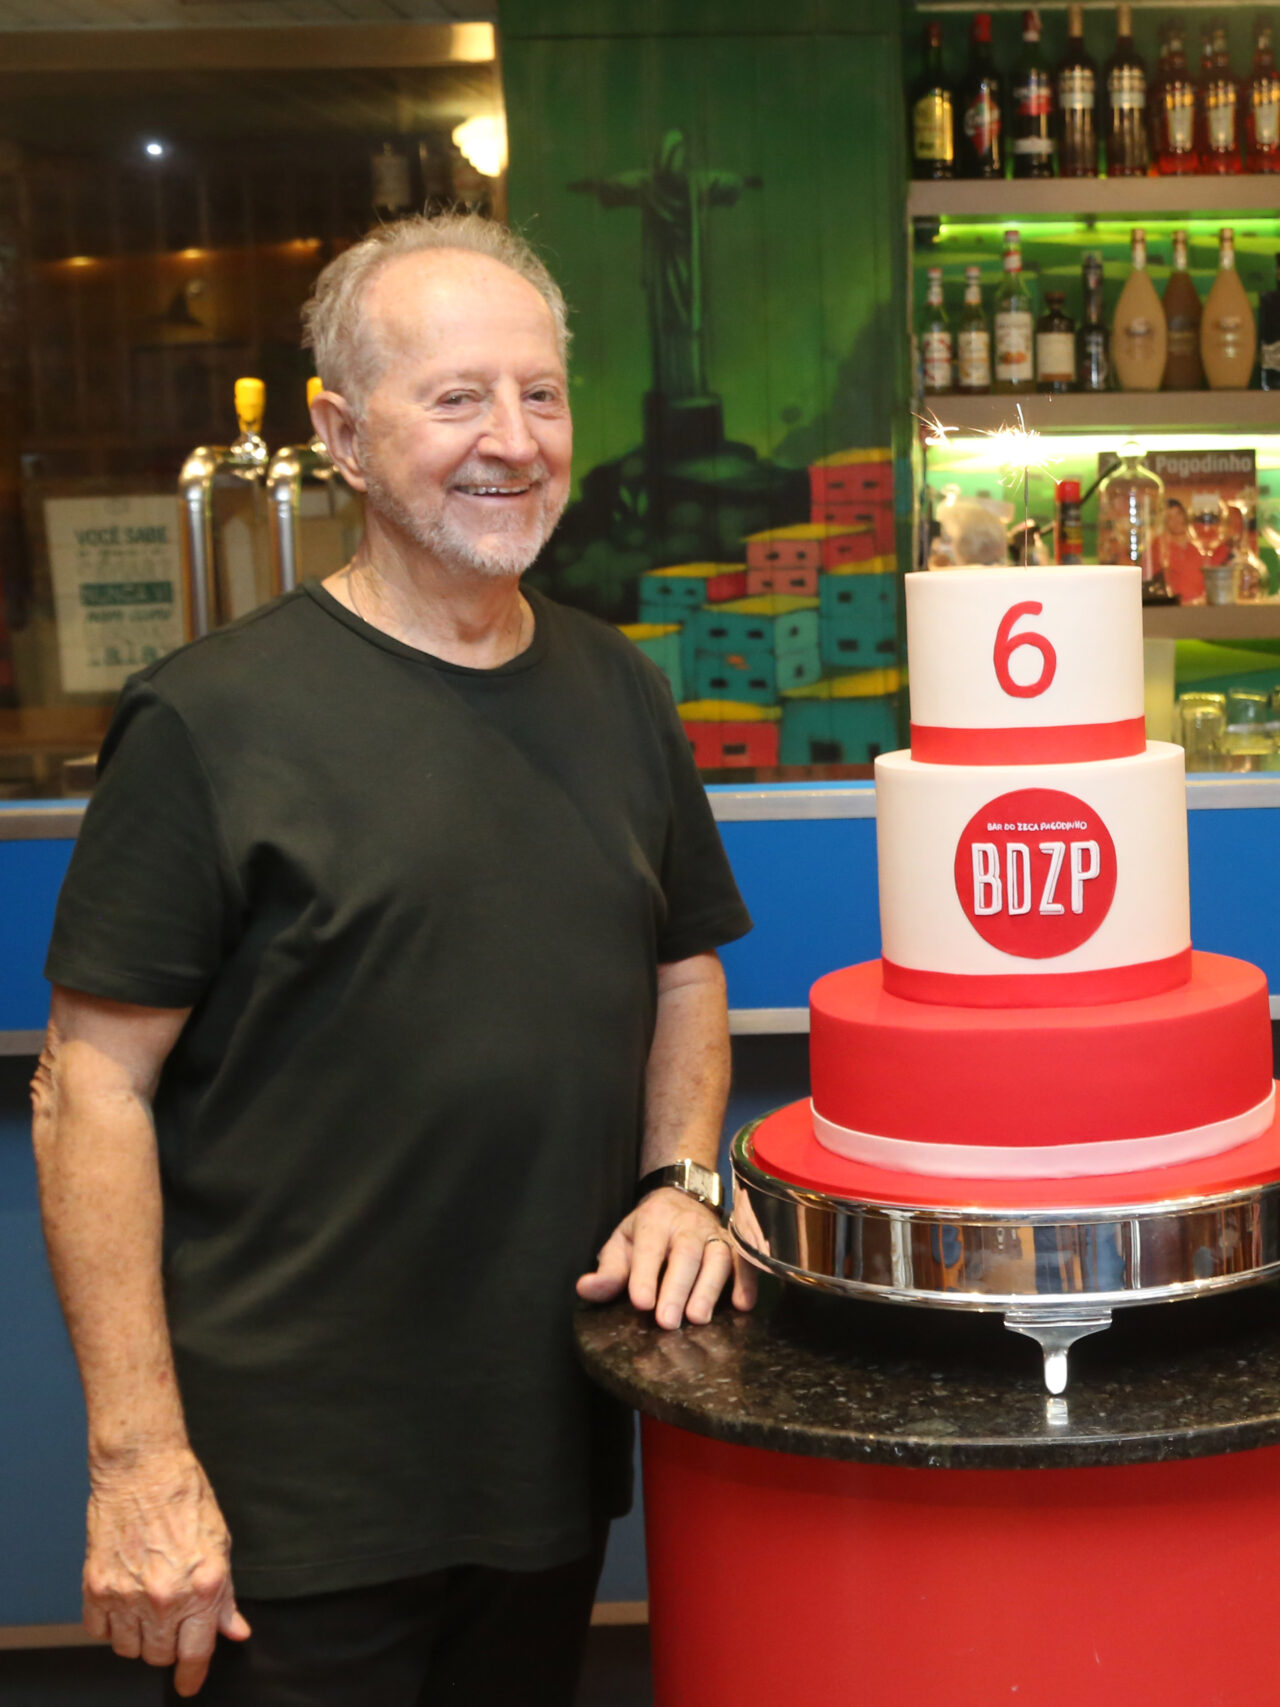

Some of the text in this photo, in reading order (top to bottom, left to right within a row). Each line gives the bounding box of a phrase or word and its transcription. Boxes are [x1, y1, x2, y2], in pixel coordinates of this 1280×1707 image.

[1155, 454, 1251, 478] Pagodinho
[993, 600, 1057, 699] 6
[986, 820, 1088, 832] BAR DO ZECA PAGODINHO
[971, 840, 1101, 917] BDZP
